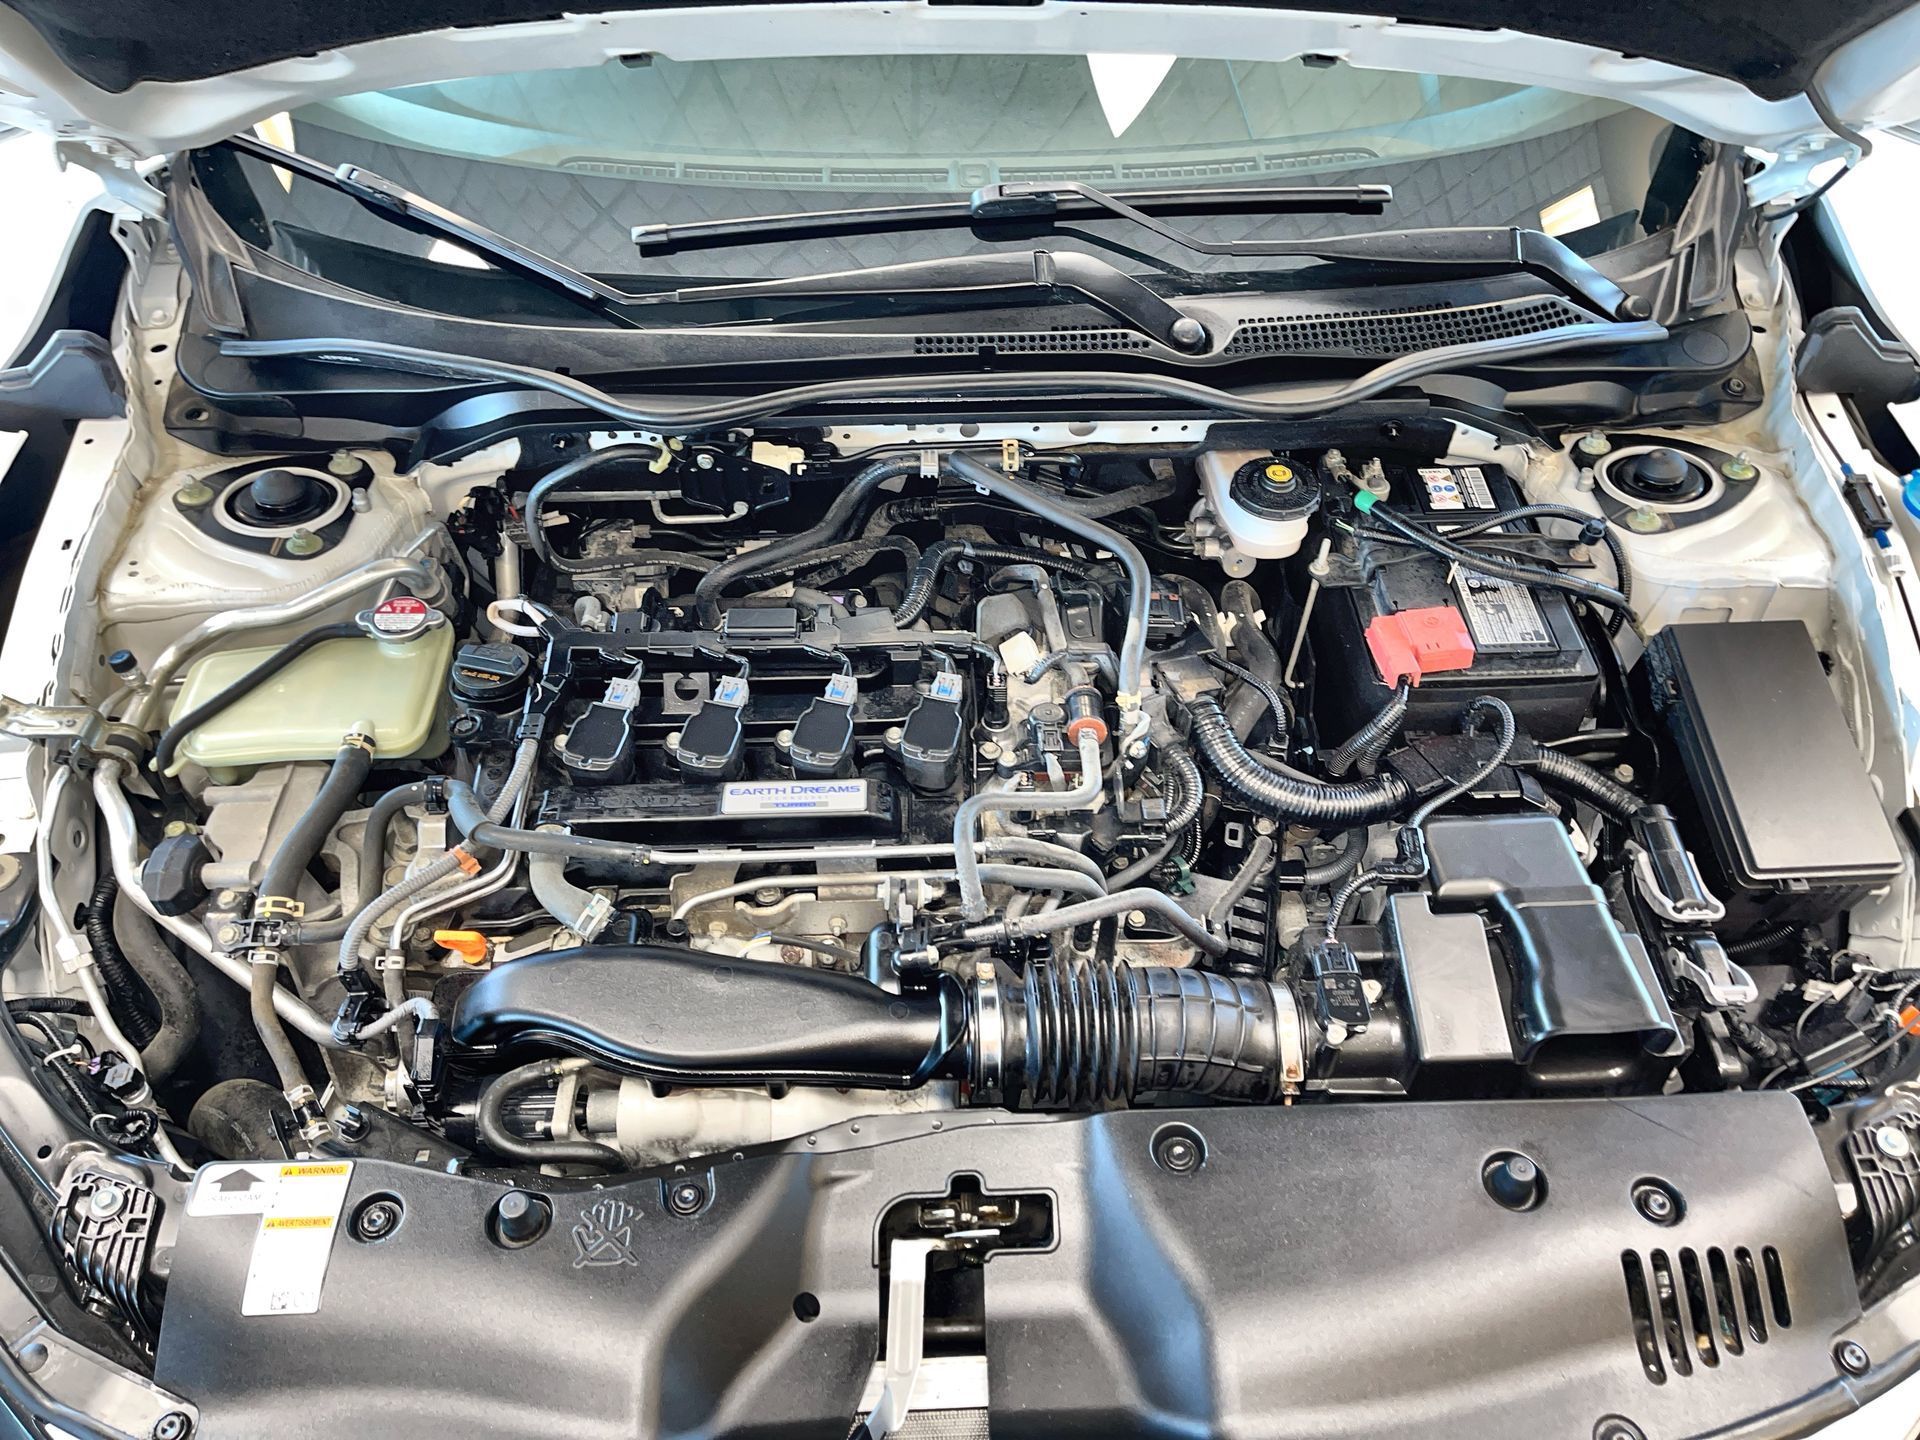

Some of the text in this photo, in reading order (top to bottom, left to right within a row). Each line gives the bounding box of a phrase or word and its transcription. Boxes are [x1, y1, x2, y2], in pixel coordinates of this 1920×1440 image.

[729, 785, 861, 796] EARTH DREAMS
[297, 1166, 344, 1175] WARNING
[277, 1217, 332, 1227] AVERTISSEMENT
